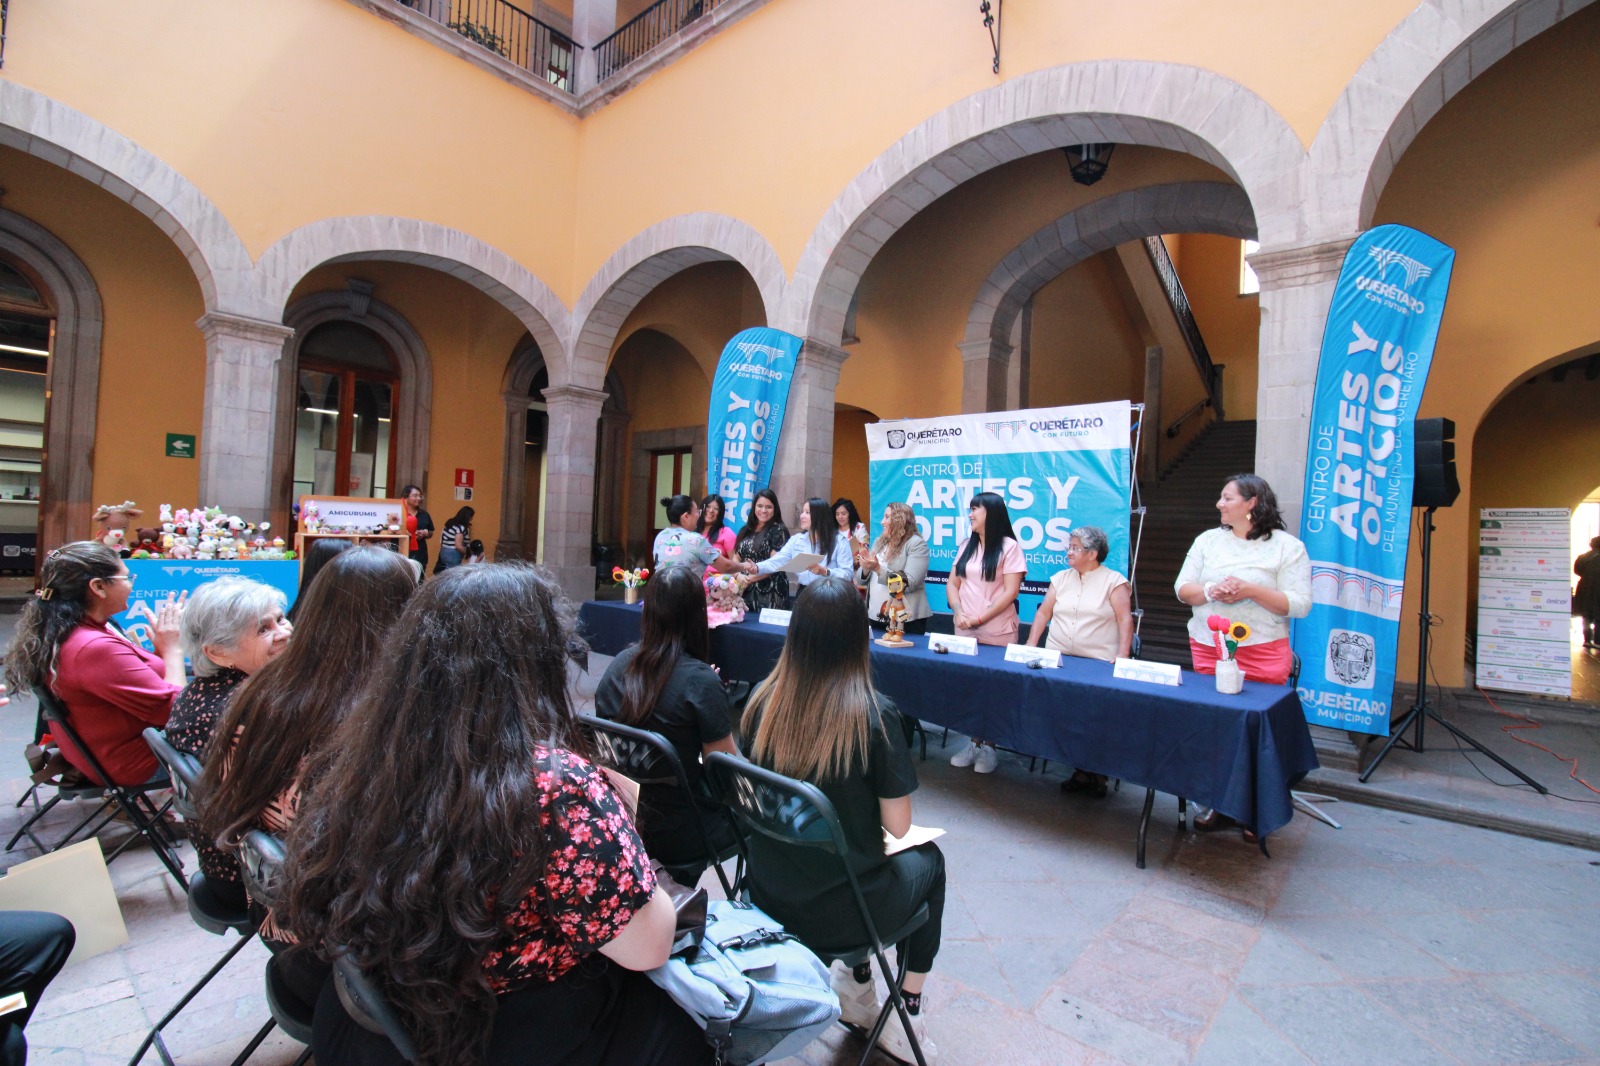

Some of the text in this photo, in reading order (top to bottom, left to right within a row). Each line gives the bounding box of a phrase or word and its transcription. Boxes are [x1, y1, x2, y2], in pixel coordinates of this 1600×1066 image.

[1355, 275, 1425, 314] QUERÉTARO
[1365, 292, 1382, 304] CON
[729, 362, 783, 381] QUERÉTARO
[1030, 417, 1104, 432] QUERÉTARO
[1060, 430, 1089, 438] FUTURO
[1329, 320, 1380, 541] ARTES Y
[907, 427, 962, 442] QUERÉTARO
[918, 438, 951, 446] MUNICIPIO
[1361, 340, 1405, 546] OFICIOS
[719, 390, 751, 524] ARTES Y
[740, 399, 771, 524] OFICIOS
[761, 454, 769, 465] DE
[904, 462, 984, 478] CENTRO DE
[1307, 425, 1334, 533] CENTRO DE
[906, 476, 1080, 511] ARTES Y
[915, 515, 1073, 551] OFIOS
[1383, 526, 1396, 553] DEL
[1025, 553, 1069, 565] RÉTARO
[193, 566, 240, 574] QUERÉTARO
[1296, 686, 1387, 716] QUERÉTARO
[1317, 708, 1372, 726] MUNCIPIO
